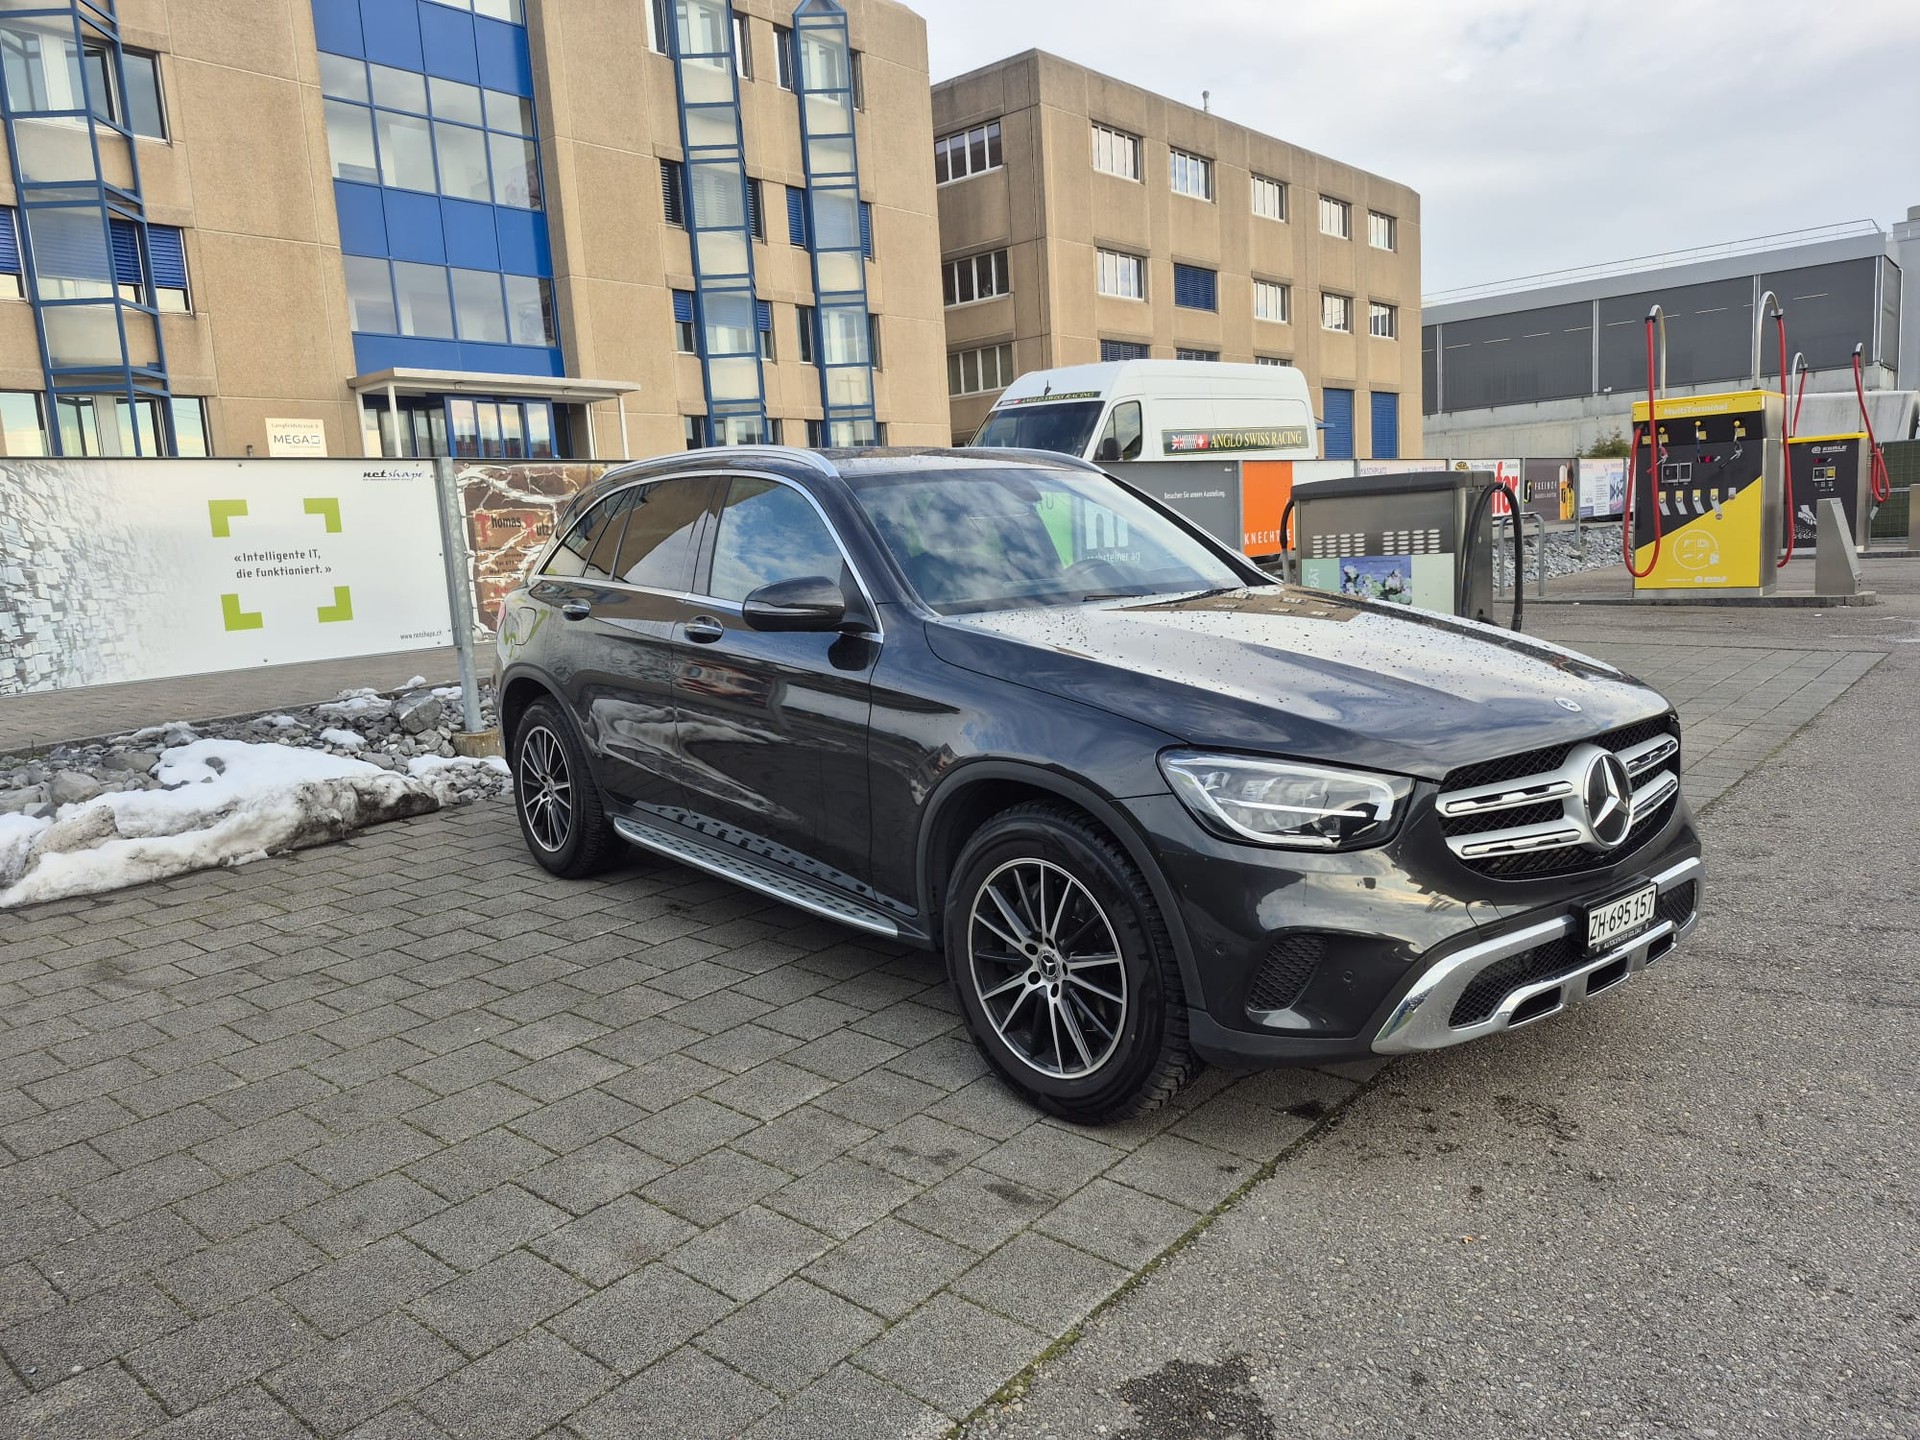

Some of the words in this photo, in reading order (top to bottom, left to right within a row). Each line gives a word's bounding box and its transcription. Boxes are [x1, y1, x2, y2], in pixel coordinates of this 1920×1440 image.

[1663, 403, 1728, 416] MultiTerminal
[273, 434, 310, 445] MEGA
[1210, 433, 1243, 449] ANGLO
[1244, 432, 1270, 447] SWISS
[1271, 430, 1302, 445] RACING
[475, 513, 521, 543] Thomas
[1244, 529, 1291, 546] KNECHTE
[308, 548, 322, 560] IT,
[236, 568, 253, 579] die
[1633, 890, 1655, 921] 157
